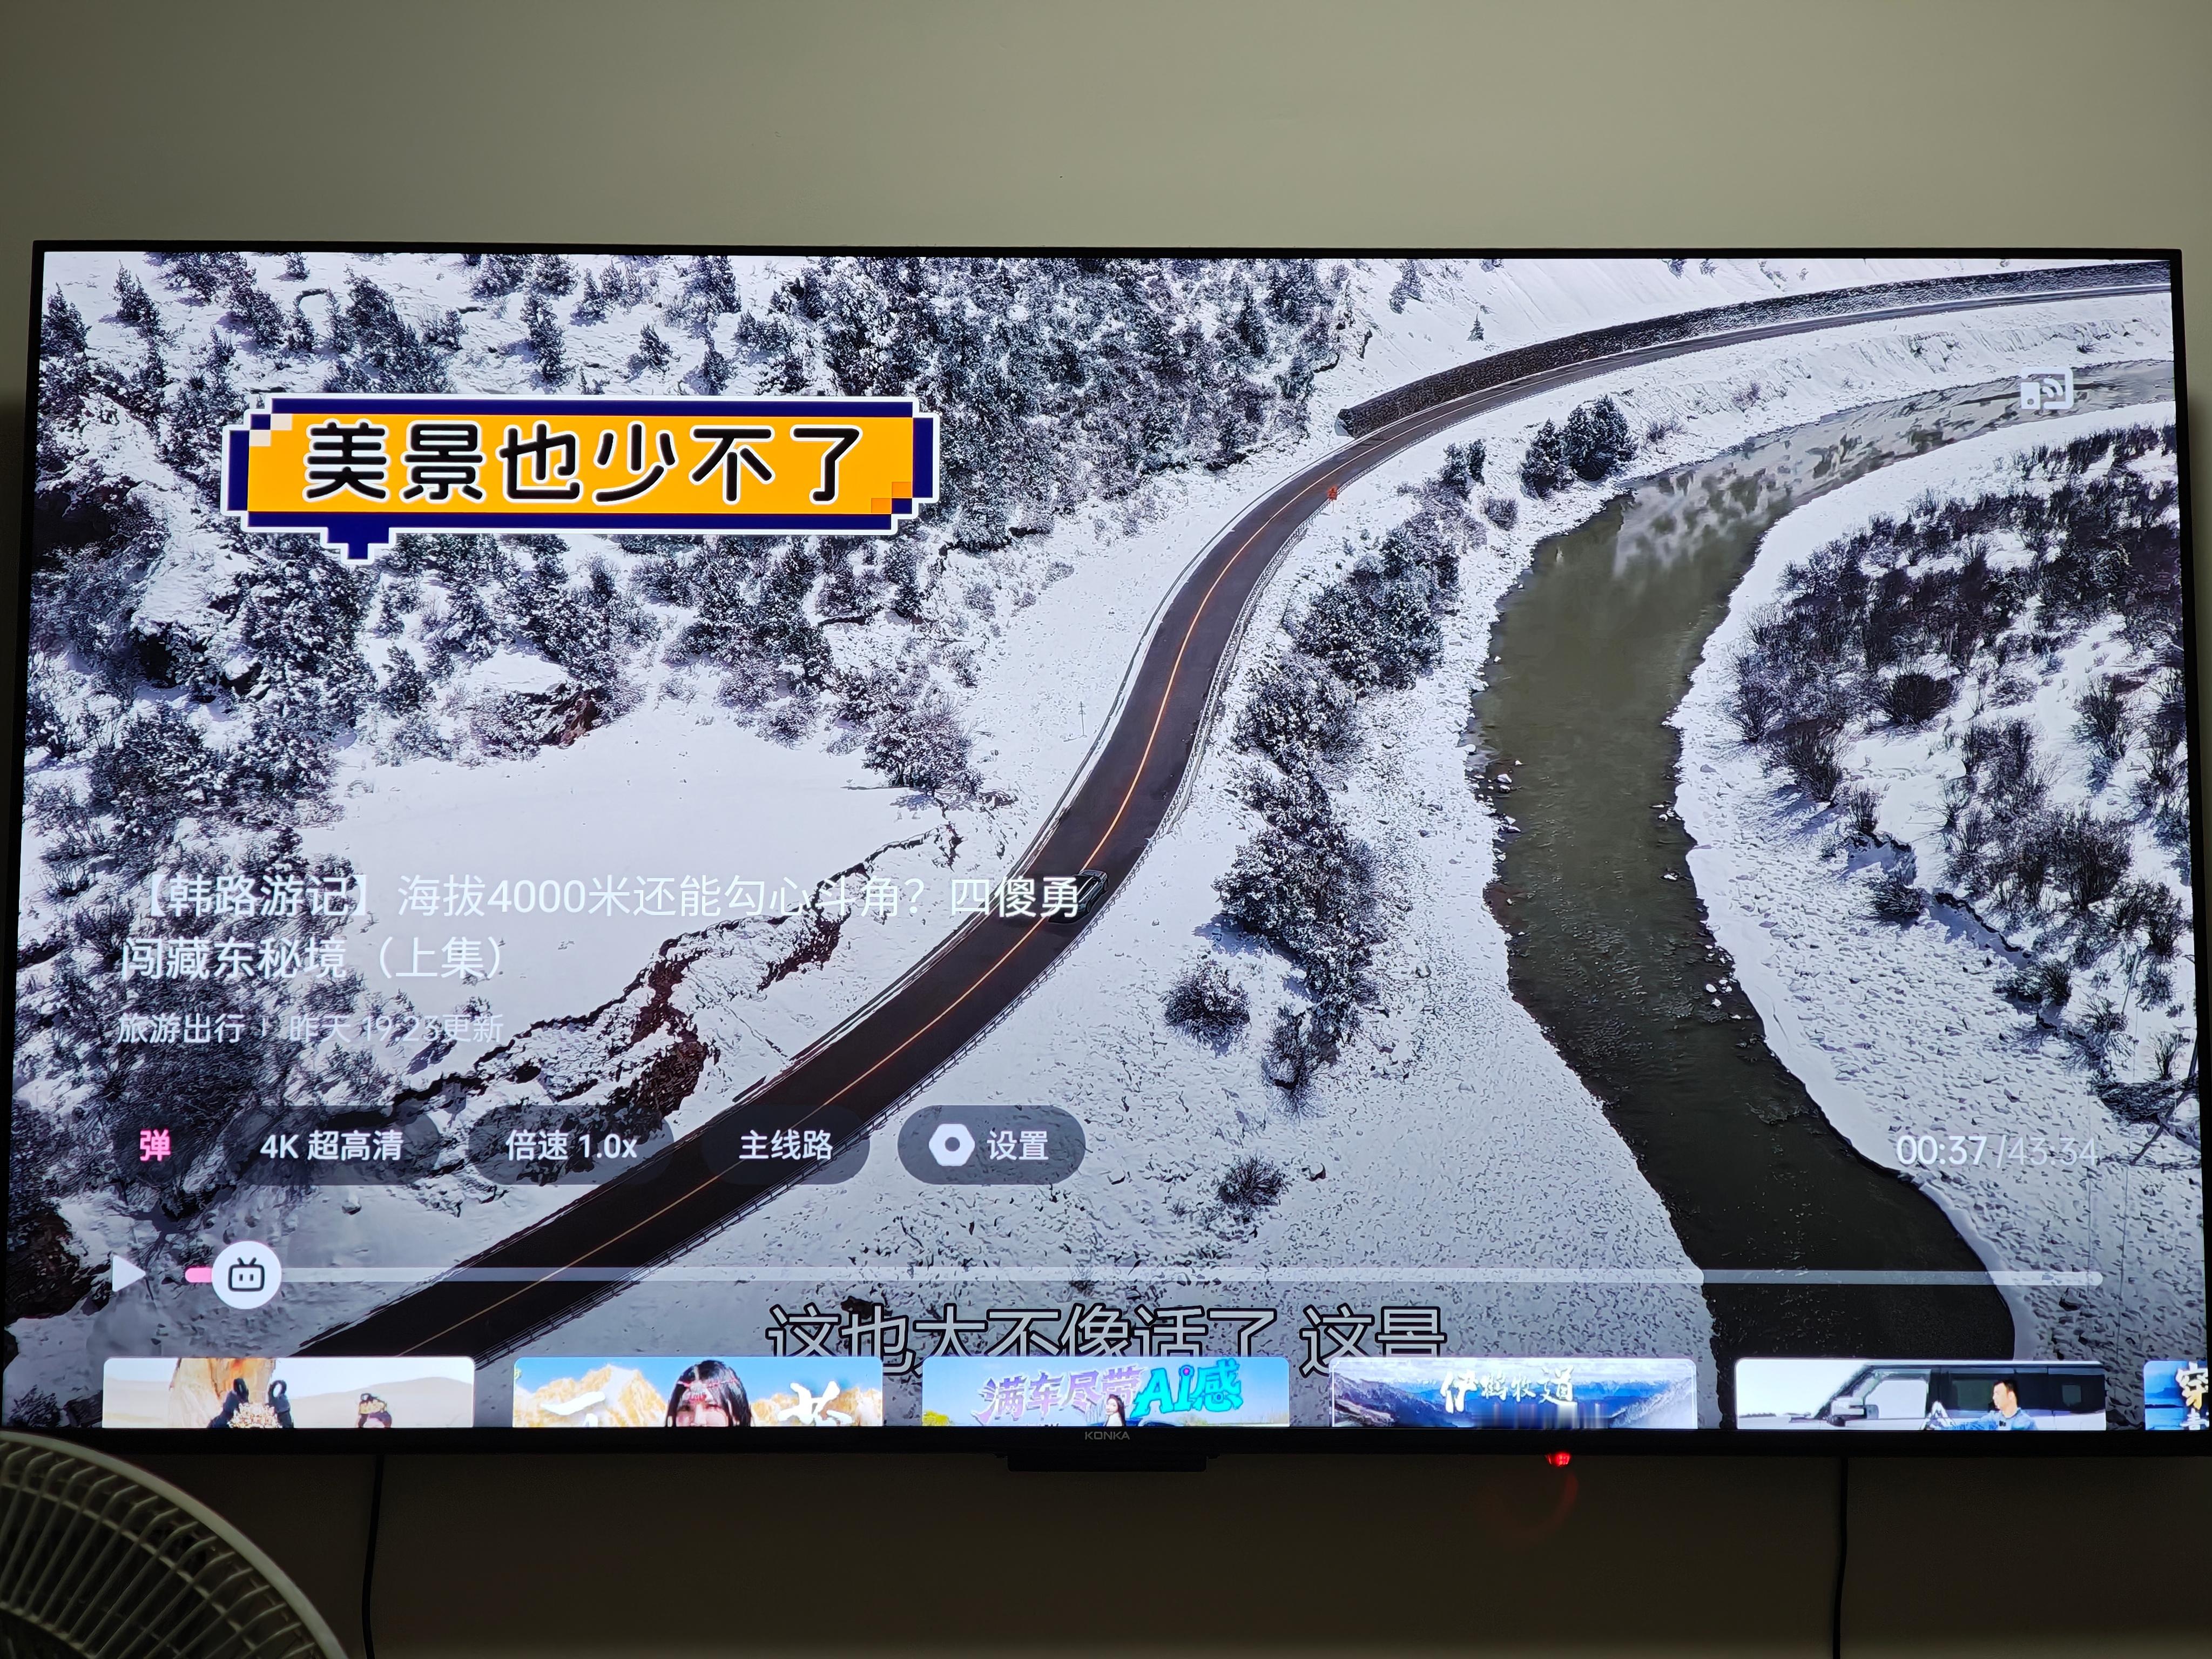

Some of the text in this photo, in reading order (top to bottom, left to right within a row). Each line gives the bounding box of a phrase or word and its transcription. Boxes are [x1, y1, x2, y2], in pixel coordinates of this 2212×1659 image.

[302, 419, 864, 505] 美景也少不了
[117, 1012, 245, 1044] 旅游出行
[290, 1014, 350, 1043] 昨天
[139, 1129, 172, 1162] 弹
[260, 1130, 404, 1162] 4K 超高清
[505, 1129, 637, 1162] 倍速 1.0x
[739, 1129, 833, 1161] 主线路
[987, 1130, 1049, 1161] 设置
[1896, 1135, 1987, 1165] 00:37
[1084, 1431, 1131, 1440] KONKA
